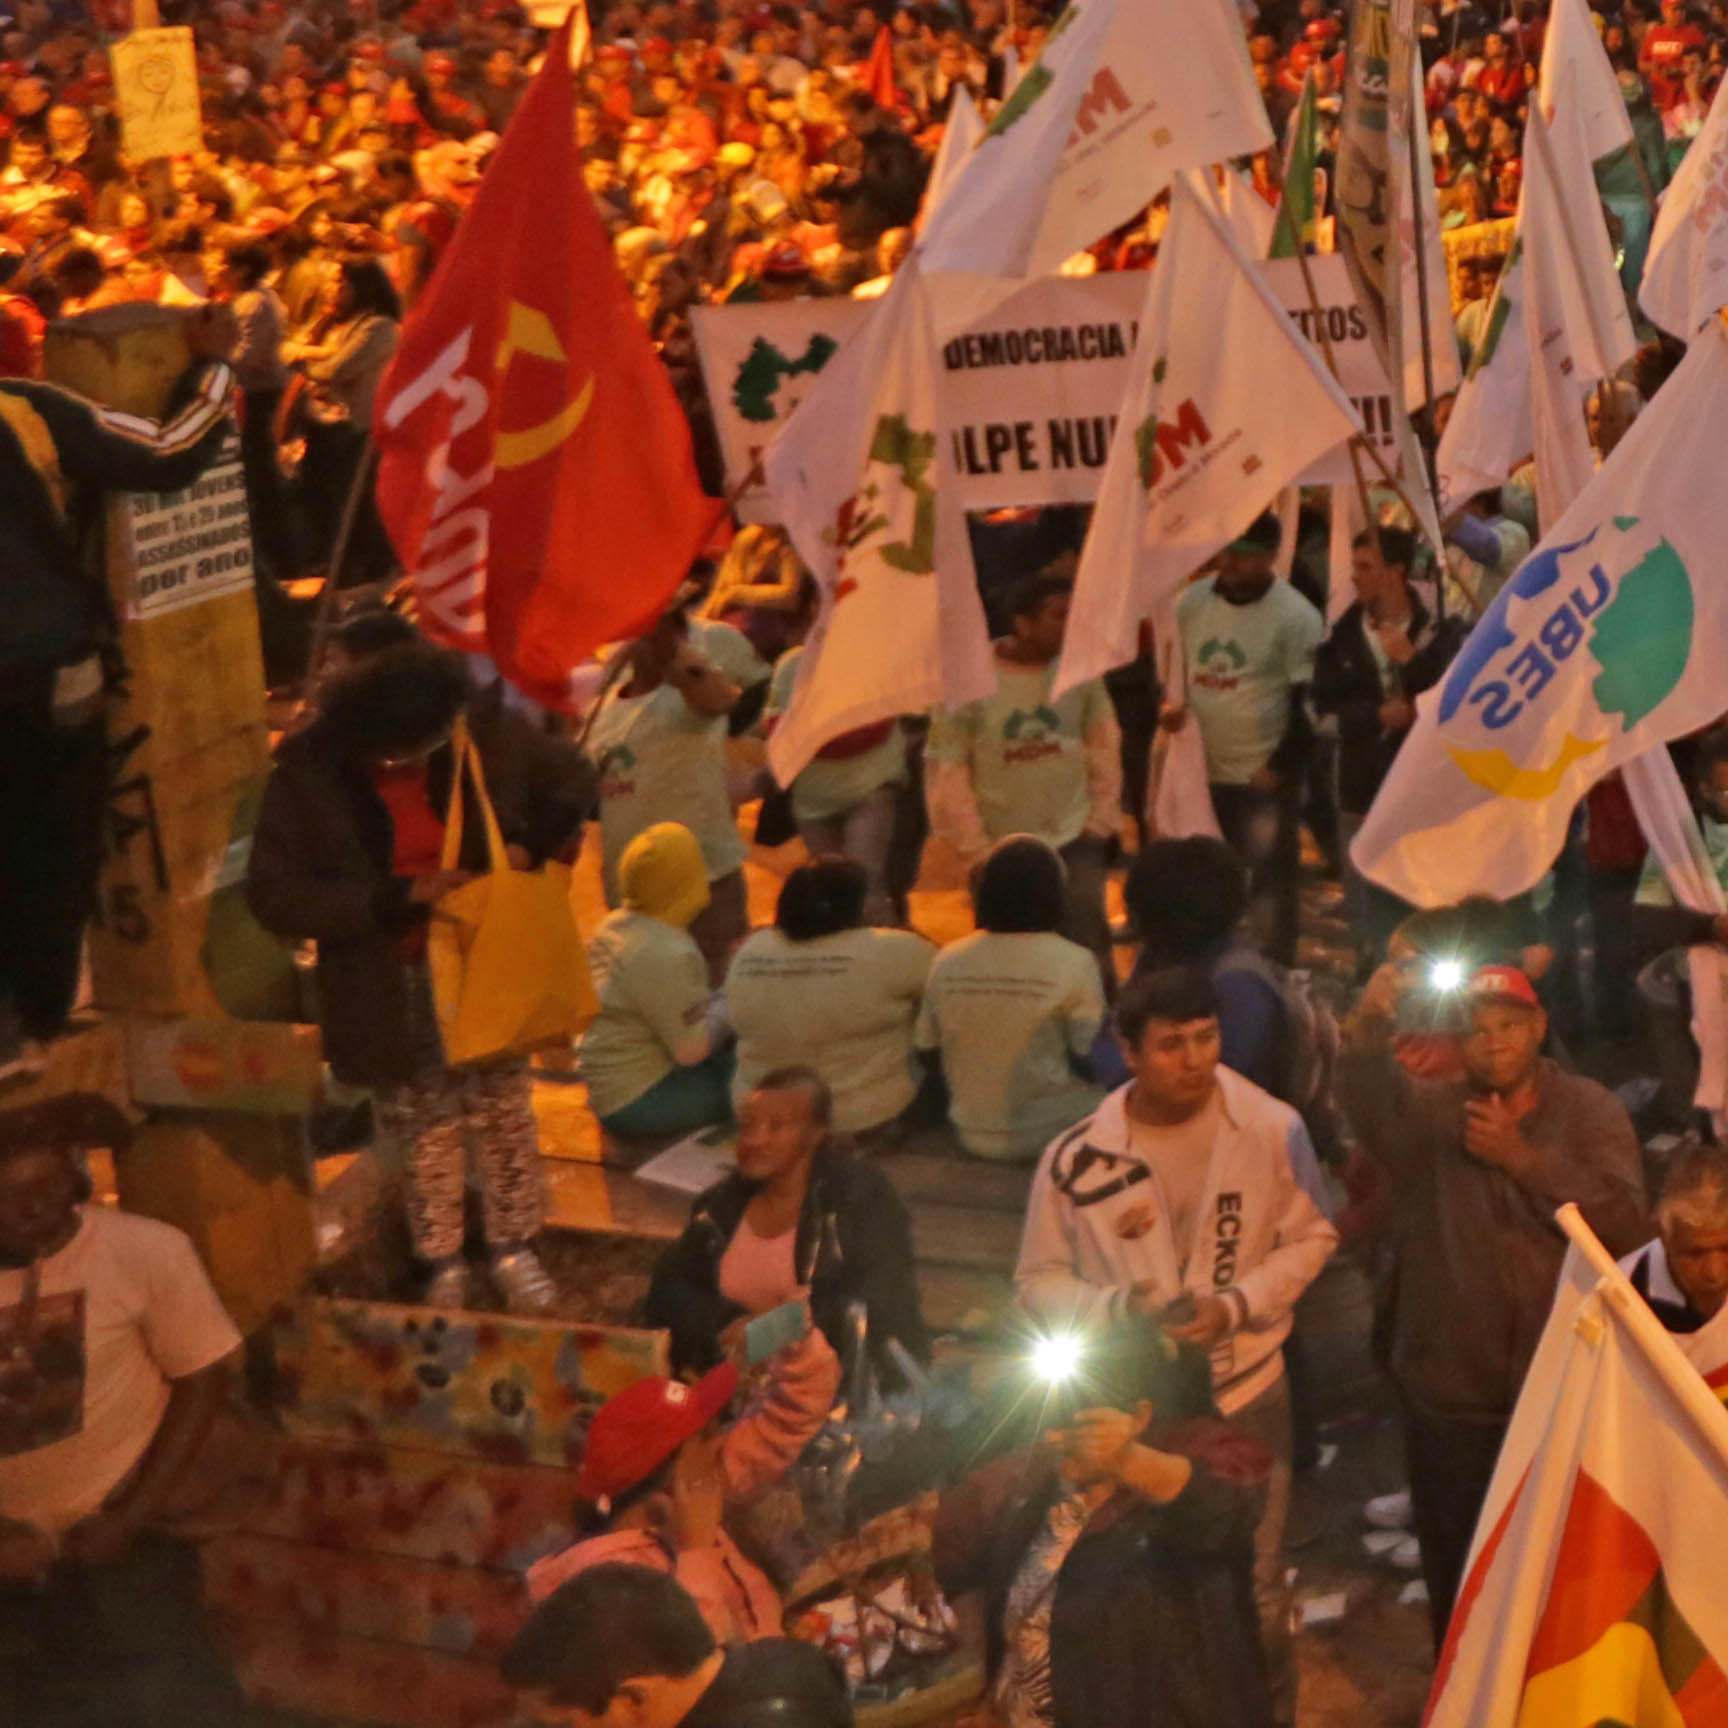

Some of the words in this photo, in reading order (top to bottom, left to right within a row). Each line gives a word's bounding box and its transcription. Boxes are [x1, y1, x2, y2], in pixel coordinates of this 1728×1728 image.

[944, 321, 1126, 372] DEMOCRACIA
[139, 563, 189, 598] por
[196, 546, 250, 580] ano
